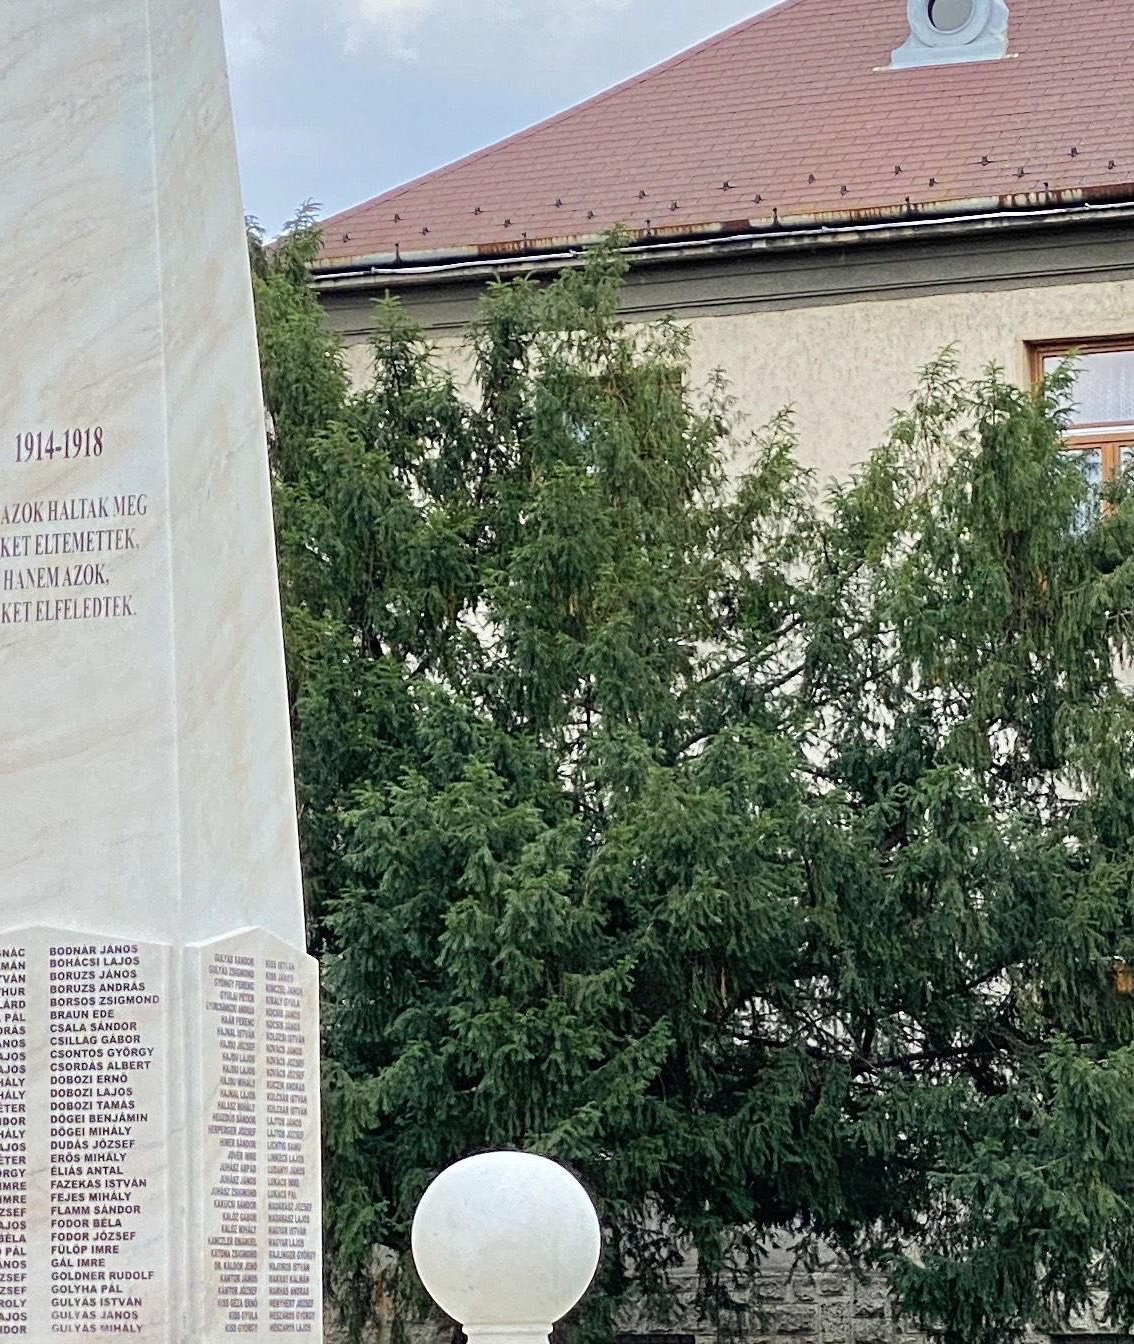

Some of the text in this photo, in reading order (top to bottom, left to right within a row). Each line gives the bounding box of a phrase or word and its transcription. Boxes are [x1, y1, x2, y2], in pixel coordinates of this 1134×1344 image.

[15, 426, 103, 463] 1914-1918
[1, 501, 44, 524] AZOK
[48, 496, 109, 521] HALTAK
[113, 494, 148, 516] MEG
[35, 528, 139, 555] ELTEMETTEK,
[3, 563, 109, 591] HANEM AZOK,
[35, 595, 137, 622] ELFELEDTEK.
[99, 943, 139, 954] JÁNOS
[49, 956, 140, 968] BOHÁCSI LAJOS
[50, 968, 137, 981] BORUZS JÁNOS
[50, 980, 145, 994] BORUZS ANDRÁS
[50, 995, 160, 1007] BORSOS ZSIGMOND
[4, 1011, 26, 1022] PÁL
[50, 1009, 115, 1020] BRAUN EDE
[50, 1020, 137, 1033] CSALA SÁNDOR
[50, 1033, 141, 1046] CSILLAG GÁBOR
[50, 1049, 103, 1059] CSONTOS
[50, 1059, 151, 1072] CSORDÁS ALBERT
[50, 1075, 93, 1085] DOBOZI
[50, 1087, 133, 1098] DOBOZI LAJOS
[50, 1101, 93, 1111] DOBOZI
[89, 1112, 148, 1123] BENJÁMIN
[89, 1124, 132, 1136] MIHÁLY
[50, 1138, 136, 1150] DUDÁS JÓZSEF
[84, 1150, 127, 1163] MIHÁLY
[50, 1164, 124, 1176] ÉLIÁS ANTAL
[50, 1177, 147, 1189] FAZEKAS ISTVÁN
[0, 1195, 27, 1204] IMRE
[50, 1190, 132, 1202] FEJES MIHÁLY
[50, 1203, 141, 1215] FLAMM SÁNDOR
[50, 1216, 122, 1228] FODOR BÉLA
[51, 1230, 136, 1241] FODOR JÓZSEF
[5, 1245, 27, 1256] PÁL
[91, 1245, 119, 1254] IMRE
[51, 1256, 106, 1268] GÁL IMRE
[51, 1270, 155, 1281] GOLDNER RUDOLF
[101, 1282, 123, 1293] PÁL
[100, 1296, 142, 1306] ISTVÁN
